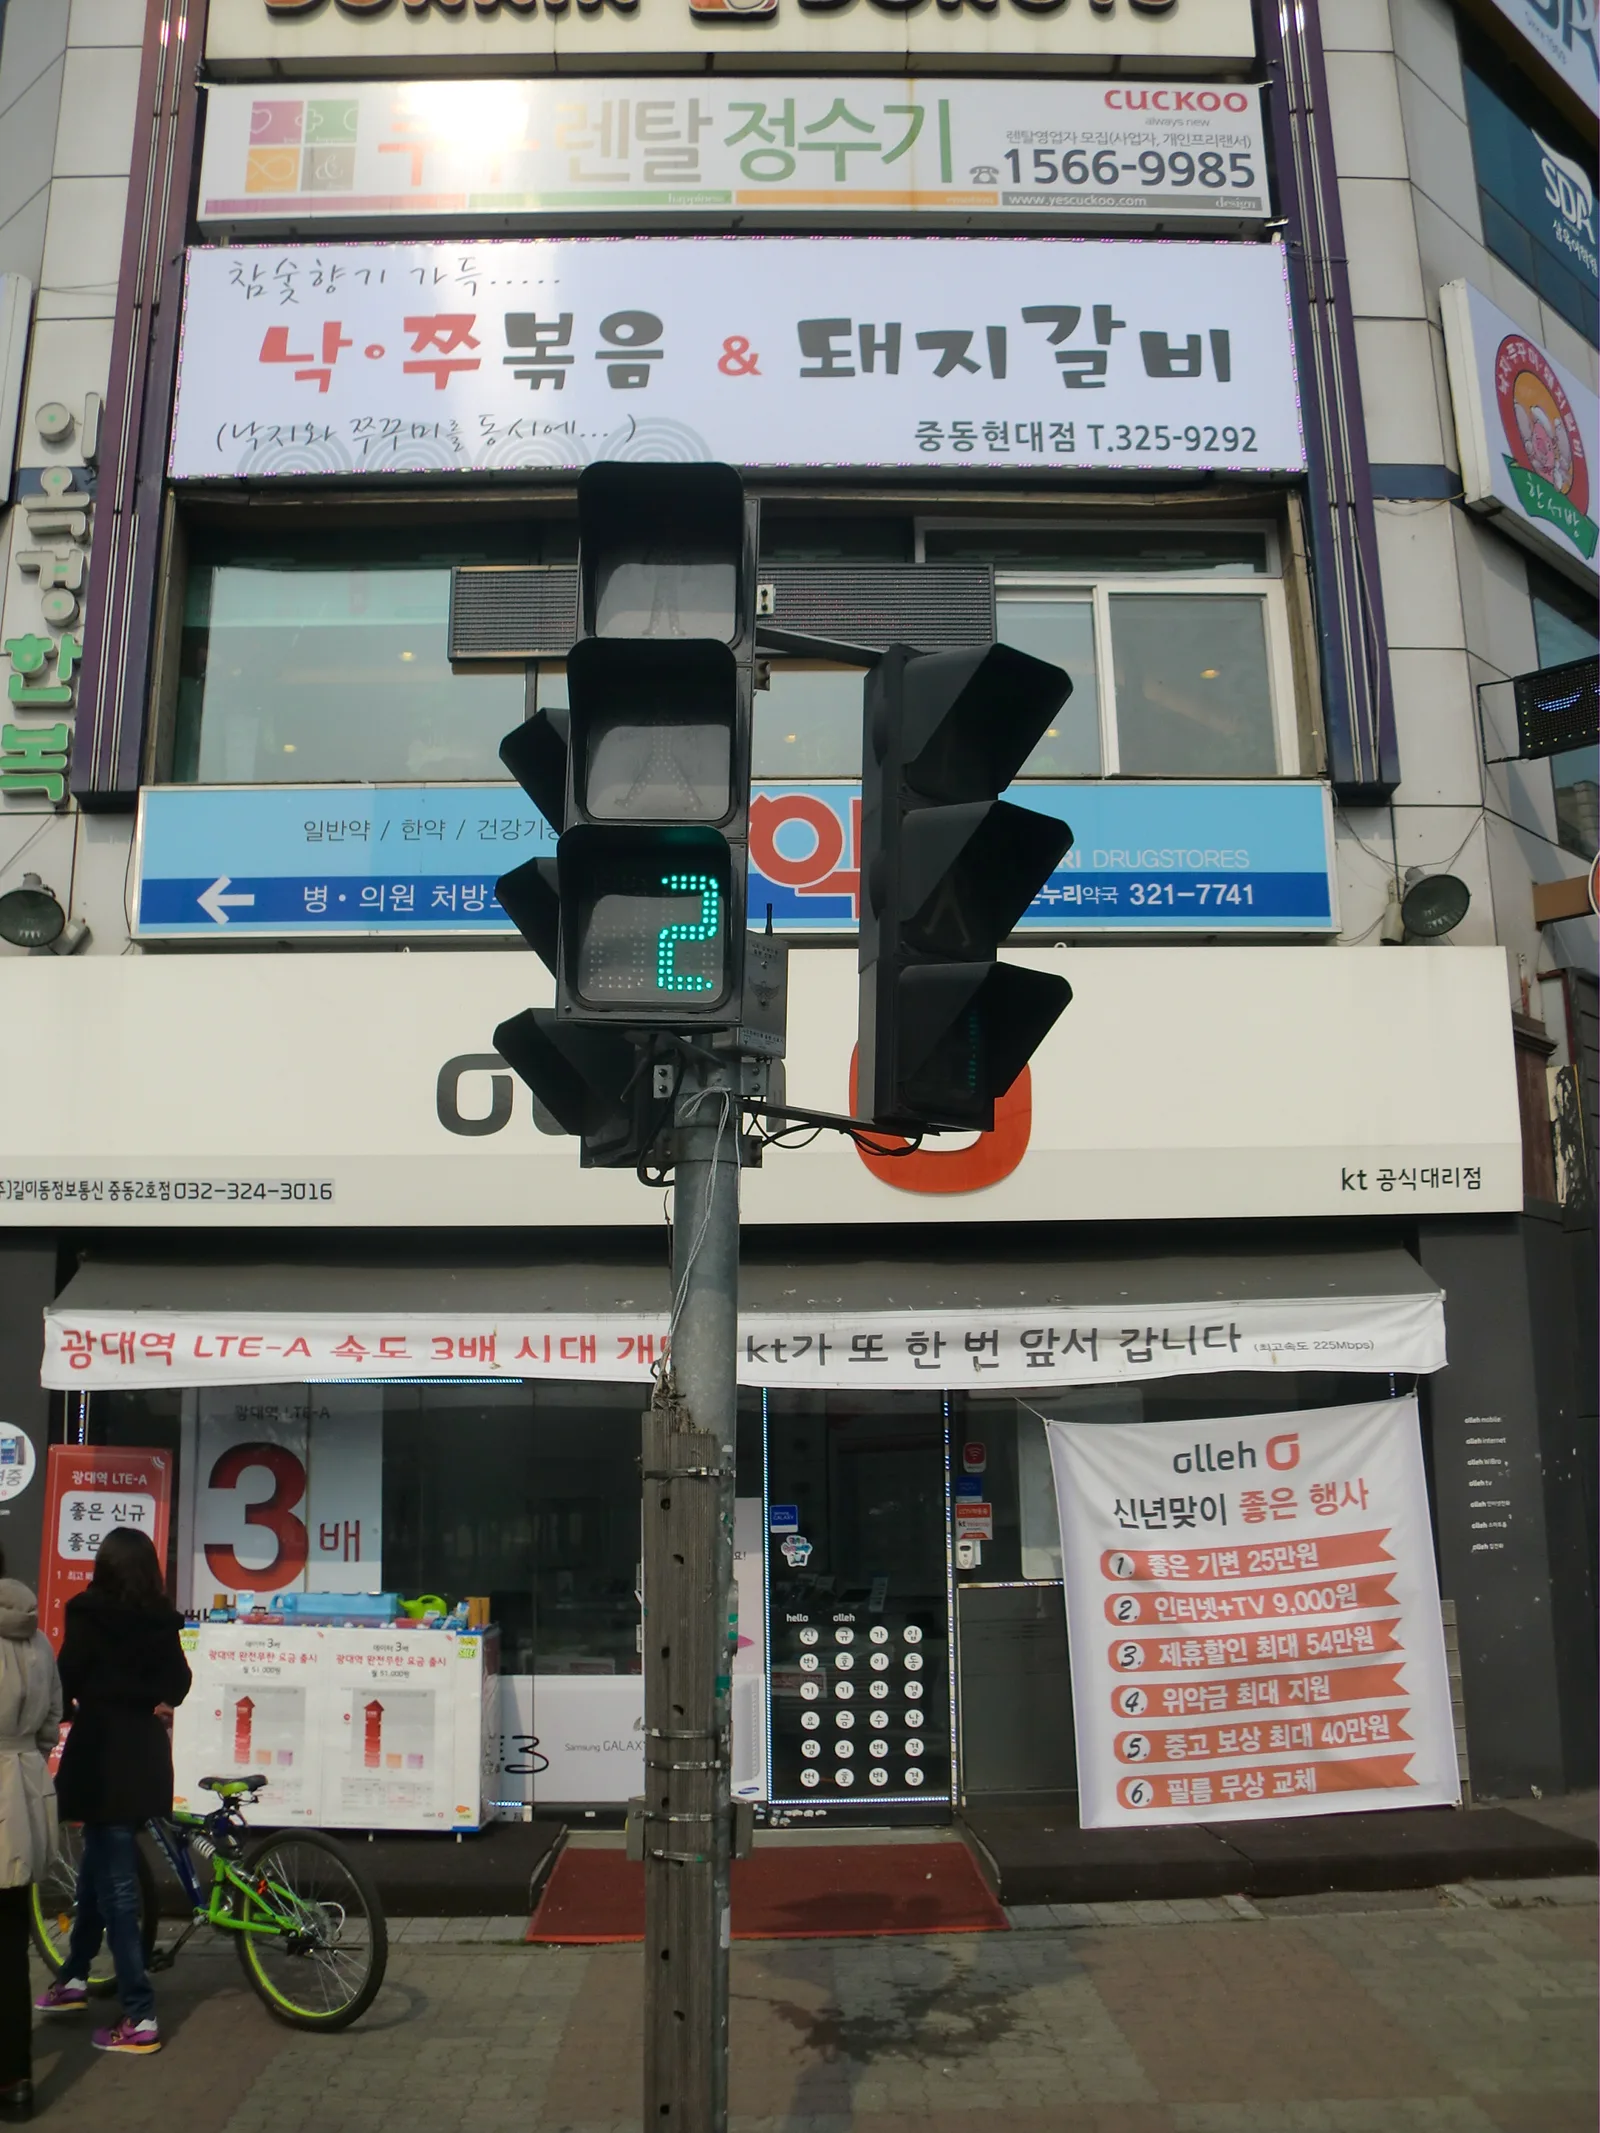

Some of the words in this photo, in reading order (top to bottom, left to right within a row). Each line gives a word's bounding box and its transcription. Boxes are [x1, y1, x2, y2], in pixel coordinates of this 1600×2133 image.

[1145, 117, 1184, 128] always
[1186, 118, 1210, 127] new
[1006, 129, 1077, 145] 렌탈영업자
[1162, 133, 1252, 150] 개인프리랜서)
[1003, 148, 1255, 189] 1566-9985
[1008, 193, 1147, 208] www.yescuckoo.com
[1215, 196, 1256, 210] design
[1541, 157, 1597, 245] SDA
[229, 257, 386, 305] 참숯향기
[717, 335, 762, 377] &
[797, 304, 1231, 389] 돼지갈비
[217, 421, 336, 453] (낙지와
[914, 420, 1076, 453] 중동현대점
[1087, 422, 1258, 453] T.325-9292
[303, 819, 371, 843] 일반약
[401, 818, 447, 842] 한약
[1092, 848, 1250, 869] DRUGSTORES
[1129, 882, 1254, 906] 321-7741
[657, 872, 719, 992] 2
[108, 1180, 171, 1202] 중동2호점
[174, 1182, 334, 1201] 032-324-3016
[1341, 1167, 1368, 1192] kt
[1375, 1166, 1482, 1193] 공식대리점
[60, 1330, 176, 1371] 광대역
[193, 1335, 313, 1360] LTE-A
[330, 1334, 414, 1363] 속도
[431, 1334, 497, 1364] 3배
[515, 1333, 598, 1365] 시대
[746, 1333, 832, 1367] kt가
[847, 1332, 889, 1364] 또
[904, 1330, 947, 1370] 한
[964, 1329, 1000, 1369] 번
[1019, 1326, 1099, 1370] 앞서
[1119, 1321, 1243, 1365] 갑니다
[1252, 1338, 1310, 1354] (최고속도
[1312, 1337, 1375, 1353] 225Mbps)
[1173, 1441, 1257, 1475] olleh
[71, 1470, 108, 1486] 광대역
[112, 1472, 148, 1485] LTE-A
[70, 1501, 105, 1522] 좋은
[111, 1503, 146, 1523] 신규
[1113, 1493, 1228, 1530] 신년맞이
[1239, 1486, 1298, 1524] 좋은
[1309, 1477, 1369, 1516] 행사
[1147, 1553, 1190, 1578] 좋은
[1196, 1550, 1241, 1578] 기변
[1247, 1542, 1319, 1574] 25만원
[54, 1598, 61, 1608] 2
[1154, 1594, 1265, 1622] 인터넷+TV
[1273, 1582, 1358, 1615] 9,000원
[786, 1612, 809, 1622] hello
[832, 1612, 856, 1622] olleh
[52, 1627, 59, 1637] 3
[208, 1650, 237, 1663] 광대역
[239, 1650, 275, 1664] 완전무한
[278, 1652, 296, 1665] 요금
[299, 1652, 318, 1665] 출시
[1158, 1636, 1248, 1668] 제휴할인
[1256, 1632, 1298, 1661] 최대
[1307, 1625, 1376, 1656] 54만원
[336, 1654, 364, 1667] 광대역
[367, 1655, 403, 1668] 완전무한
[406, 1656, 425, 1668] 요금
[428, 1656, 447, 1669] 출시
[1162, 1686, 1229, 1714] 위약금
[1236, 1679, 1279, 1706] 최대
[1288, 1674, 1332, 1703] 지원
[565, 1742, 601, 1753] Samsung
[602, 1739, 647, 1752] GALAX
[1165, 1732, 1211, 1761] 중고
[1217, 1727, 1262, 1755] 보상
[1269, 1722, 1314, 1750] 최대
[1320, 1714, 1391, 1746] 40만원
[1167, 1777, 1214, 1806] 필름
[1220, 1772, 1265, 1800] 무상
[1272, 1766, 1318, 1795] 교체
